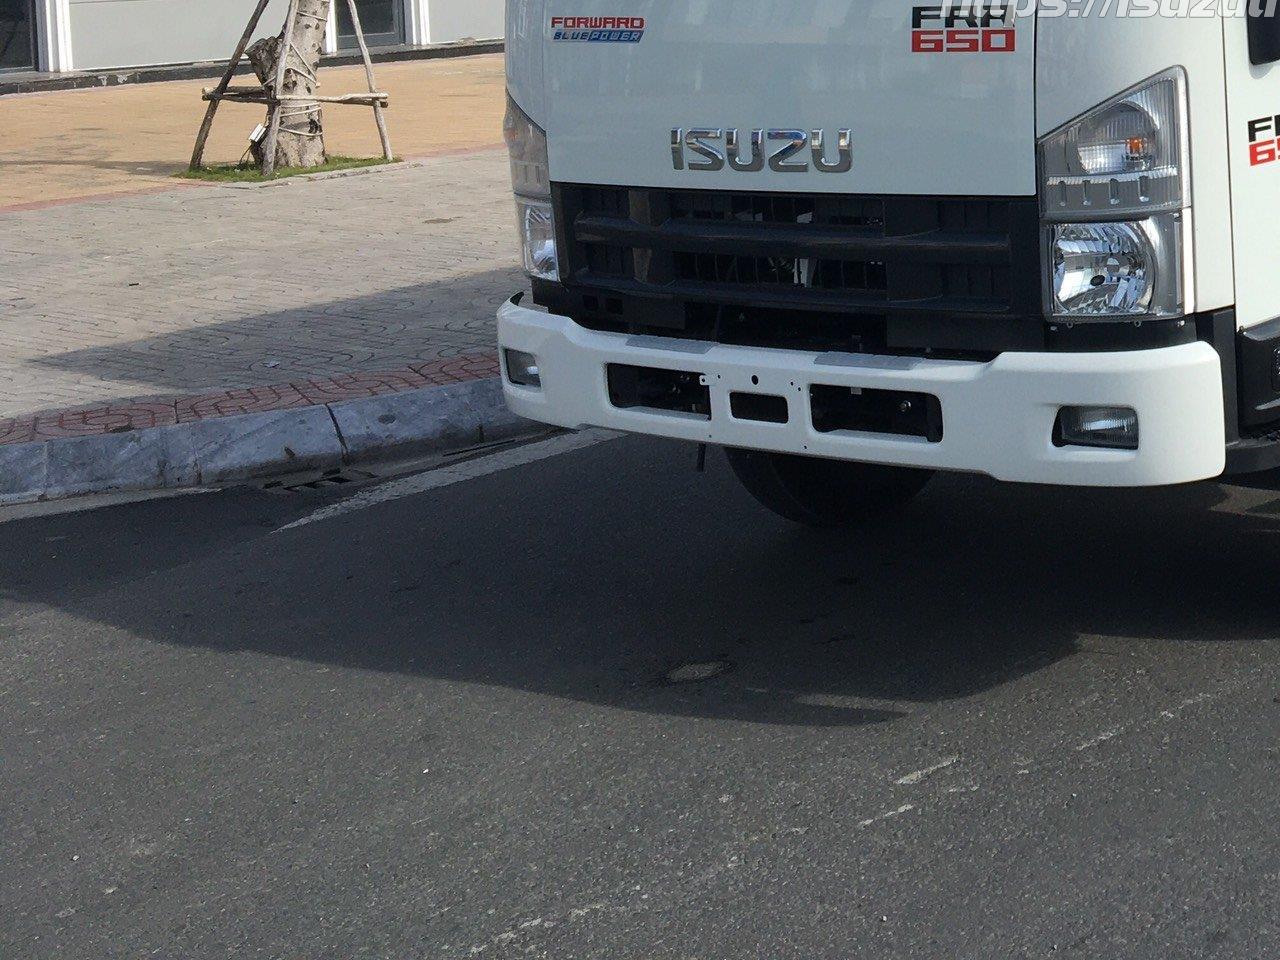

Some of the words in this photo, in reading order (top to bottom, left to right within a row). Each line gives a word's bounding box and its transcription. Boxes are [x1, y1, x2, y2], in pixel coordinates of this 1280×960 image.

[551, 16, 645, 29] FORWARD
[553, 30, 642, 41] BLUEPOWER
[911, 29, 1016, 53] 650
[670, 127, 853, 173] ISUZU
